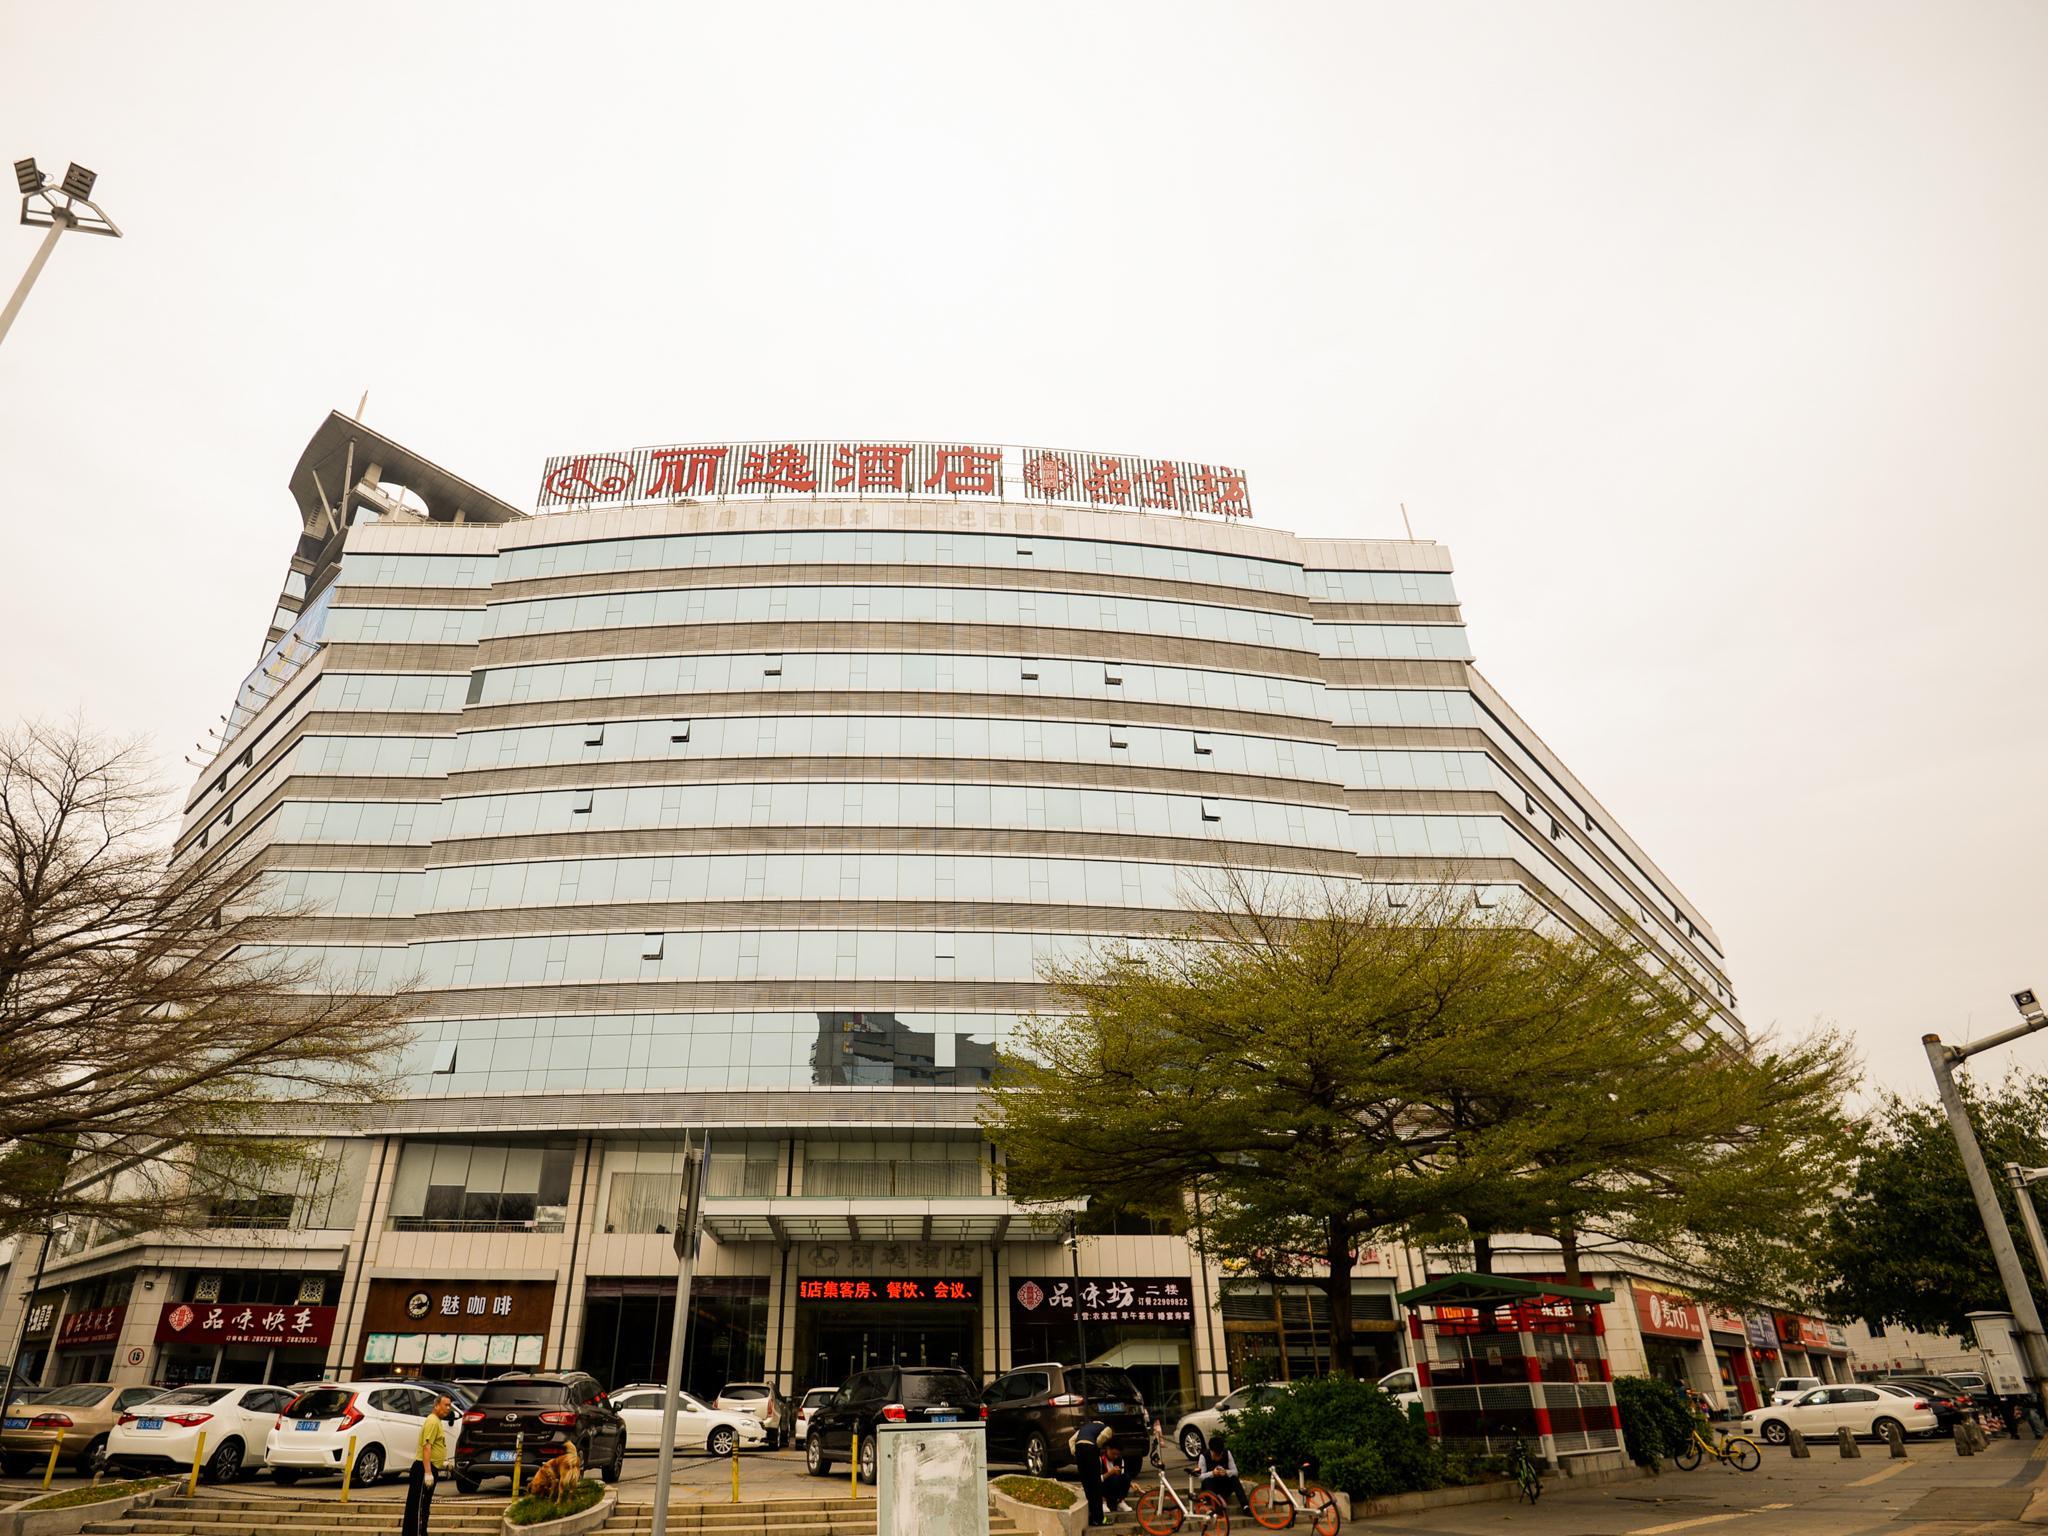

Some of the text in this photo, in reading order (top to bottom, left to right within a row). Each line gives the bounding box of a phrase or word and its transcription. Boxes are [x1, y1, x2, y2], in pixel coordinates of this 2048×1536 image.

[651, 444, 1003, 496] 丽逸酒店
[1083, 458, 1247, 504] 品味坊
[1143, 496, 1179, 510] WEI
[440, 1295, 512, 1316] 魅咖啡
[1048, 1281, 1135, 1309] 品味坊
[202, 1307, 314, 1333] 品味快车
[131, 1351, 141, 1361] 15
